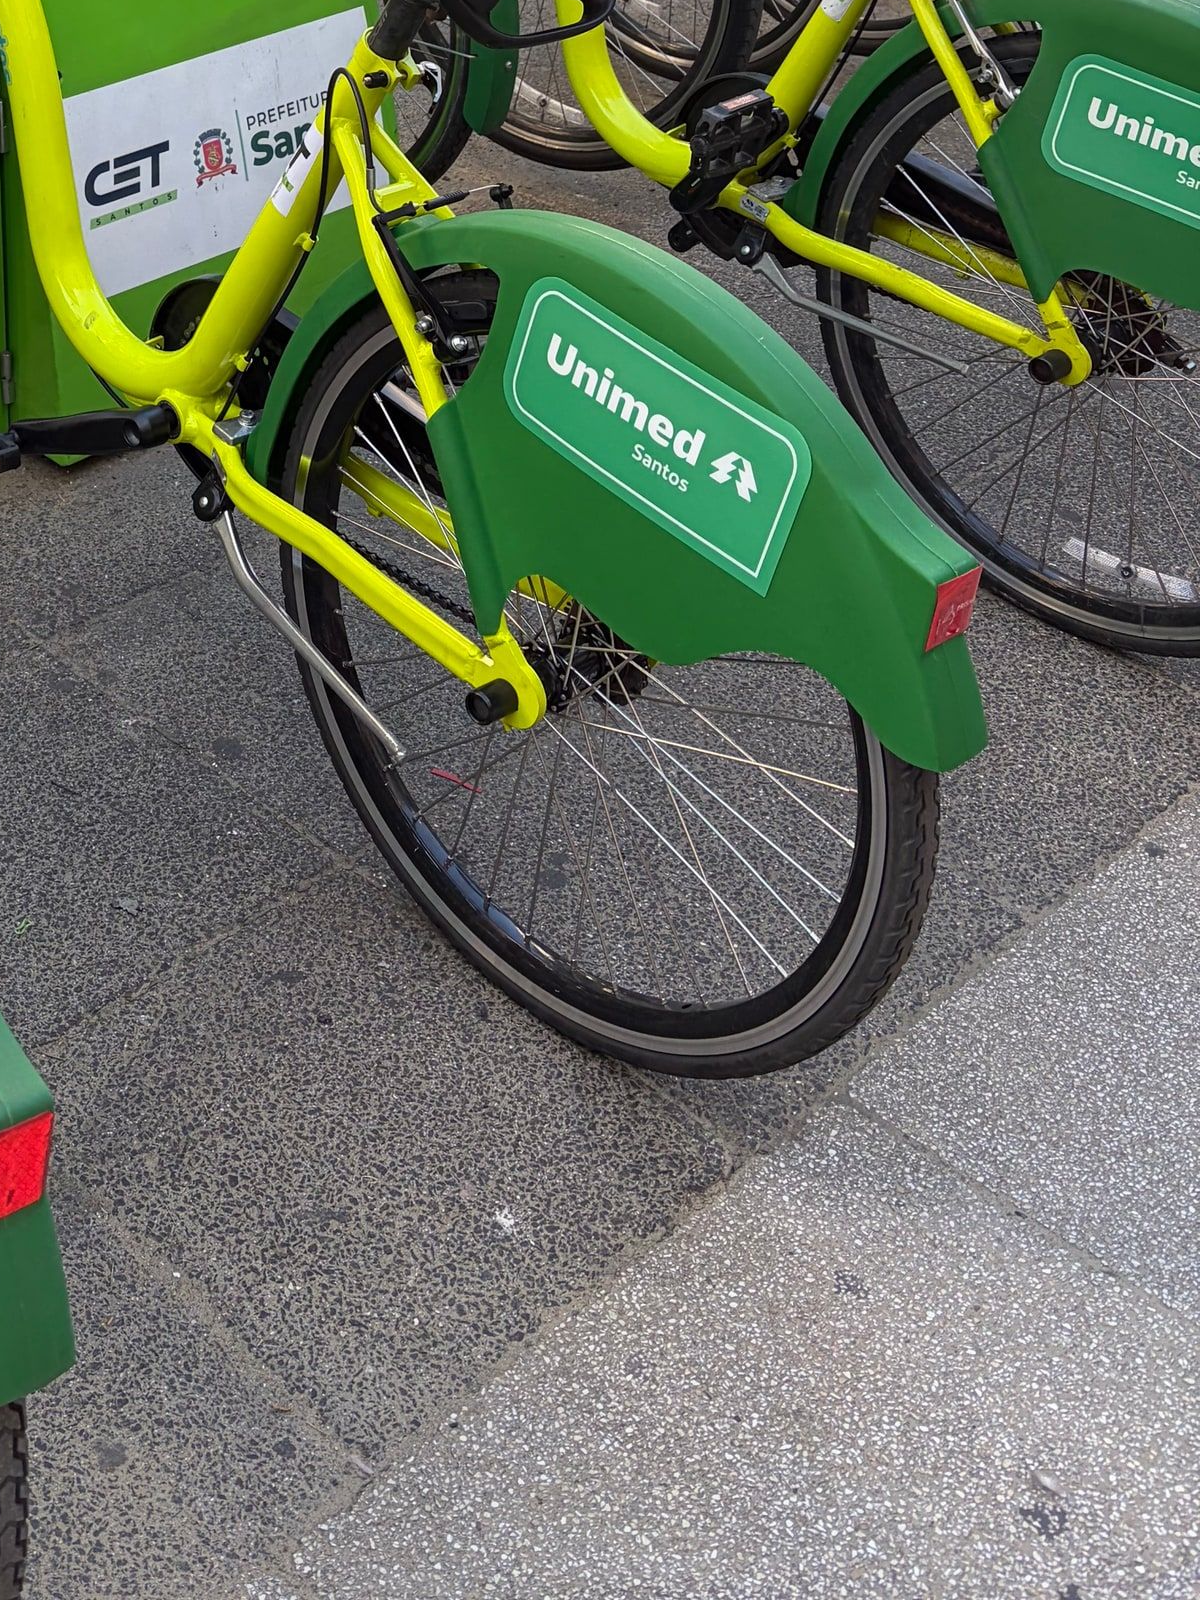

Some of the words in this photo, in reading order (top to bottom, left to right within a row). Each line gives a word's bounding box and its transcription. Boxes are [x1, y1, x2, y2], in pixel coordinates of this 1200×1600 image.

[246, 90, 329, 131] PREFEITUR
[1087, 96, 1200, 169] Unime
[250, 122, 313, 167] San
[84, 139, 170, 207] CET
[95, 192, 174, 227] SANTOS
[547, 332, 706, 467] Unimed
[631, 443, 689, 493] Santos
